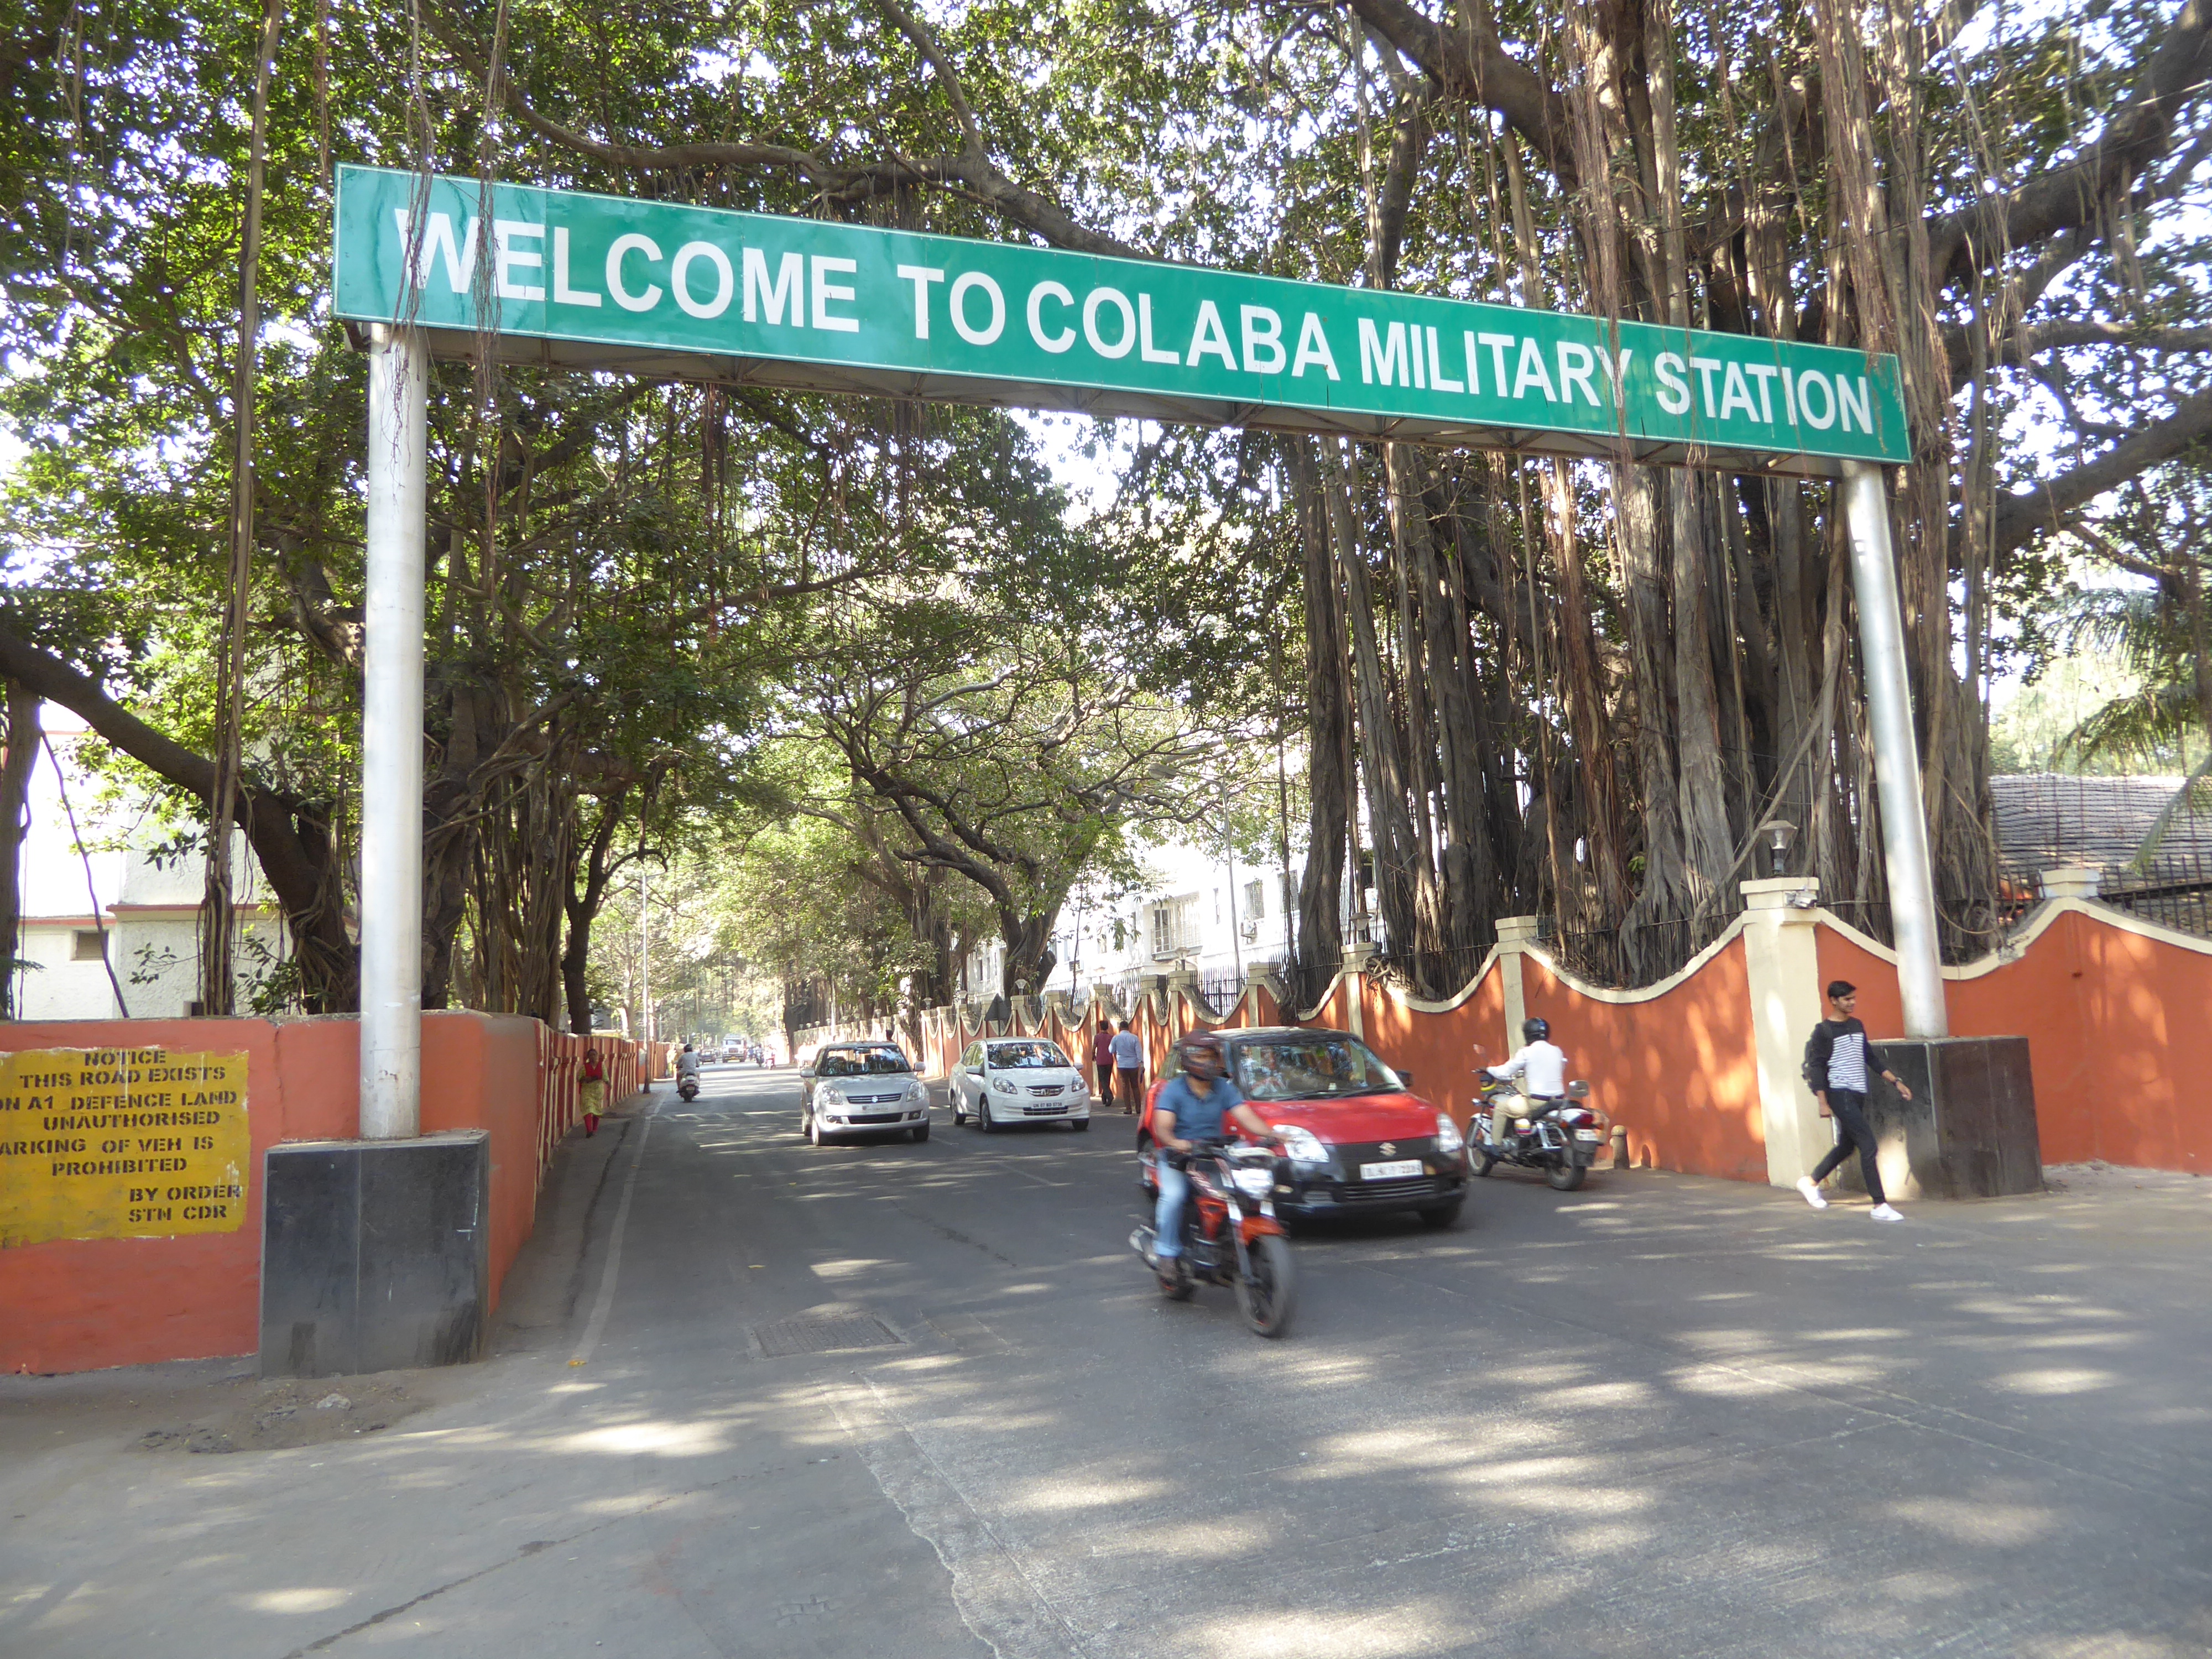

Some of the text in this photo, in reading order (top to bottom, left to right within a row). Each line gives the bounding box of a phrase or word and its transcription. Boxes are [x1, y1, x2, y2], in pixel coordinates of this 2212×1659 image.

[394, 208, 1873, 434] WELCOME TO COLABA MILITARY STATION
[85, 1051, 166, 1066] NOTICE
[19, 1067, 226, 1088] THIS ROAD EXISTS
[0, 1091, 237, 1111] N A1 DEFENCE LAND
[44, 1111, 220, 1130] UNAUTHORISED
[102, 1139, 130, 1154] OF
[138, 1138, 181, 1152] VEH
[194, 1136, 213, 1150] IS
[52, 1158, 187, 1176] PROHIBITED
[130, 1185, 241, 1202] BY ORDER
[128, 1205, 227, 1222] STN CDR
